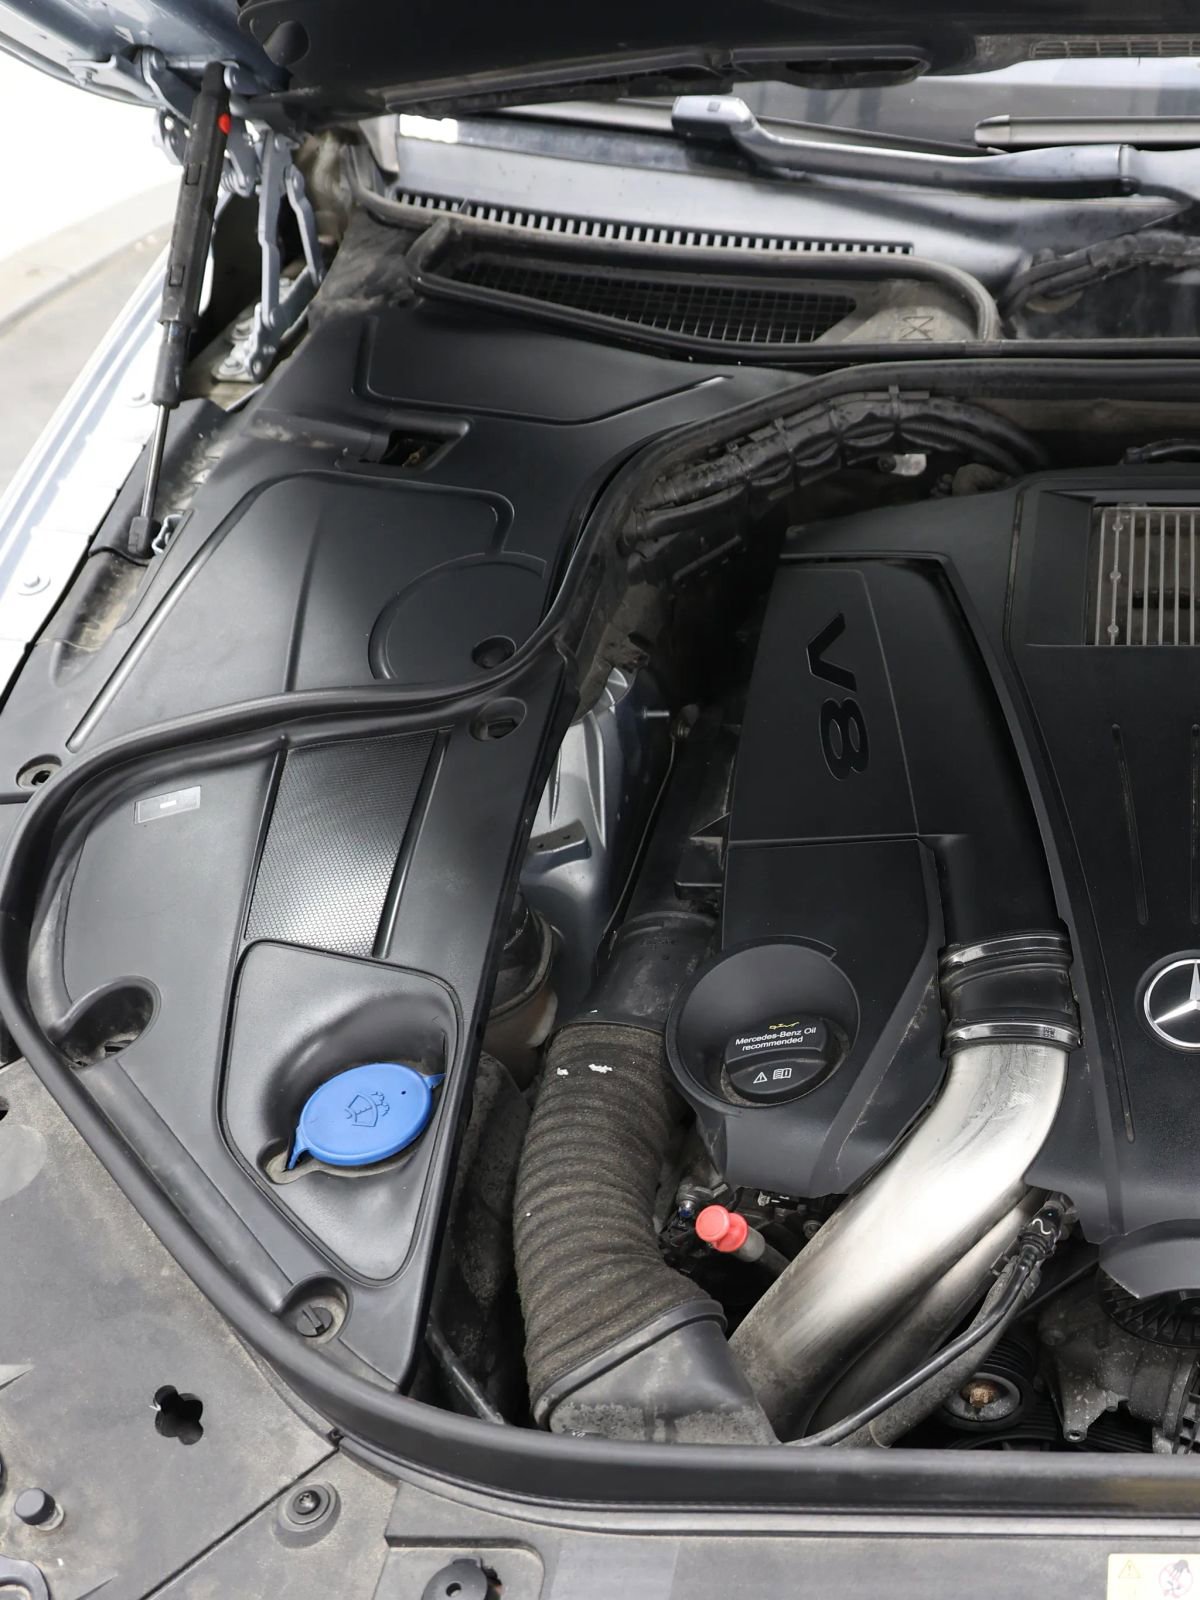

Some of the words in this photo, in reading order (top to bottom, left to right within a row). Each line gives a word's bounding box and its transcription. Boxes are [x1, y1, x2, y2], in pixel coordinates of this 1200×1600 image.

[806, 612, 870, 781] V8
[735, 1029, 802, 1046] Mercedes-Benz
[803, 1026, 817, 1035] Oil
[742, 1036, 804, 1051] recommended
